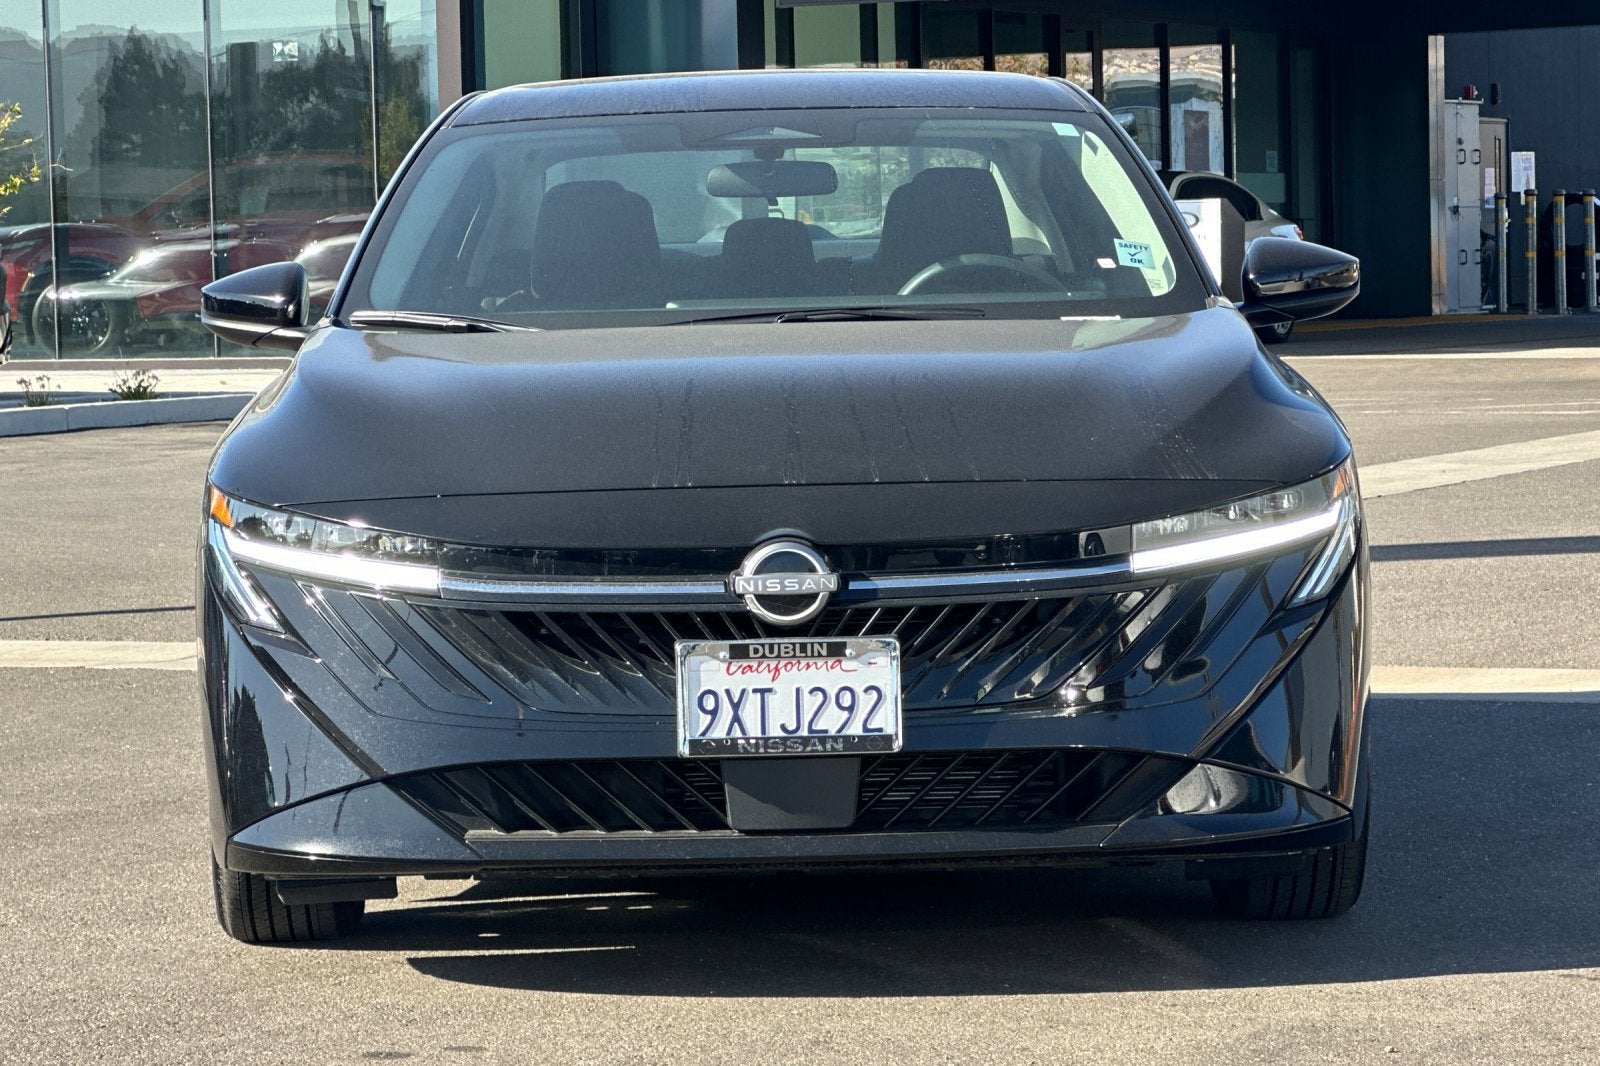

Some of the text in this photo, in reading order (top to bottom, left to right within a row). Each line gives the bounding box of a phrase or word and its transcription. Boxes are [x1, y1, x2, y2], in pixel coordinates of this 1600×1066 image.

[1118, 242, 1149, 251] SAFETY
[1130, 257, 1144, 265] OK
[739, 577, 834, 593] NISSAN
[748, 642, 828, 658] DUBLIN
[726, 658, 858, 683] California
[697, 685, 884, 737] 9XTJ292
[737, 738, 844, 754] NISSAN
